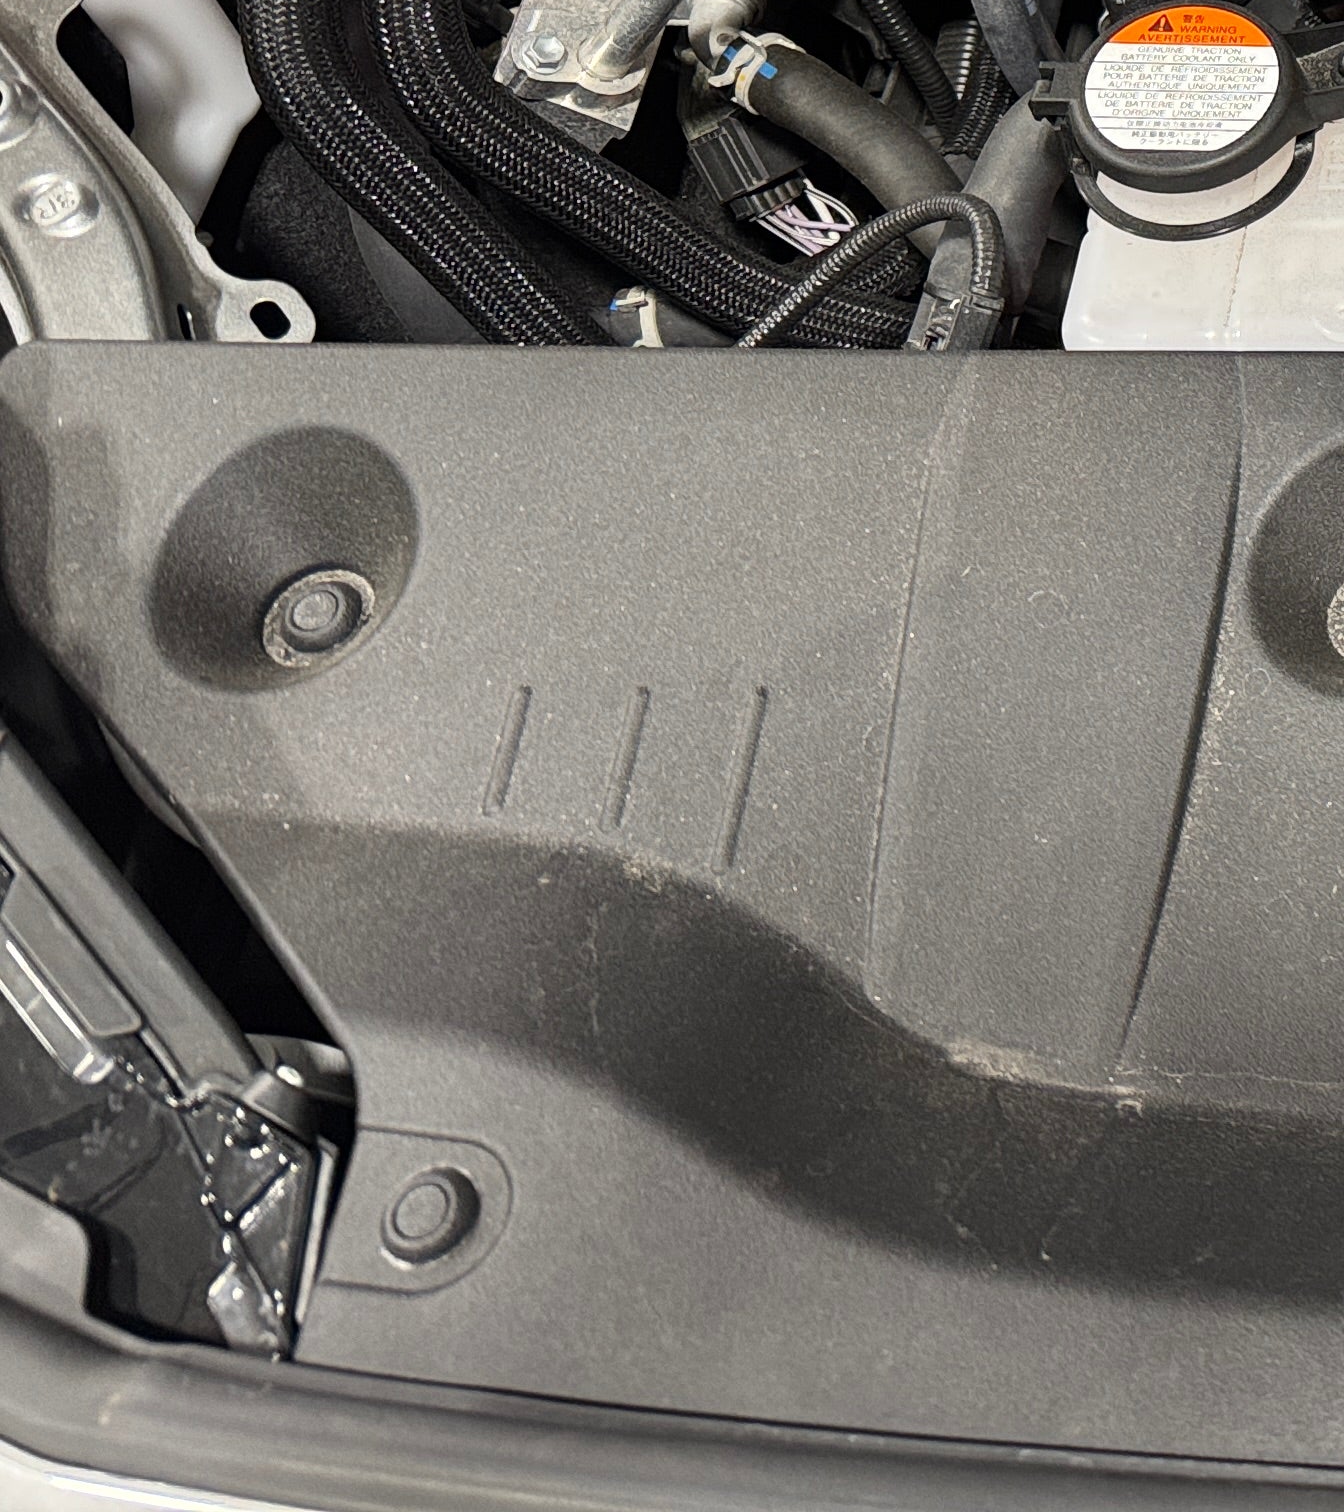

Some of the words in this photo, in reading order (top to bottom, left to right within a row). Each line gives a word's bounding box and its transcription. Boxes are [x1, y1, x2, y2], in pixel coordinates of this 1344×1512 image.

[1180, 25, 1238, 35] WARNING
[1138, 33, 1246, 44] AVERTISSEMENT
[1138, 46, 1184, 54] GENUINE
[1191, 47, 1242, 55] TRACTION
[1121, 53, 1167, 61] BATTERY
[1173, 55, 1222, 63] COOLANT
[1227, 56, 1256, 64] ONLY
[1103, 64, 1145, 72] LIQUIDE
[1103, 72, 1133, 80] POUR
[1138, 73, 1188, 81] BATTERIE
[1193, 74, 1207, 82] DE
[1214, 74, 1265, 82] TRACTION
[1108, 81, 1181, 89] AUTHENTIQUE
[1188, 82, 1257, 91] UNIQUEMENT
[1165, 93, 1263, 102] REFROIDISSEMENT
[1125, 100, 1174, 108] BATTERIE
[1180, 101, 1194, 109] DE
[1201, 102, 1253, 110] TRACTION
[1172, 109, 1242, 118] UNIQUEMENT
